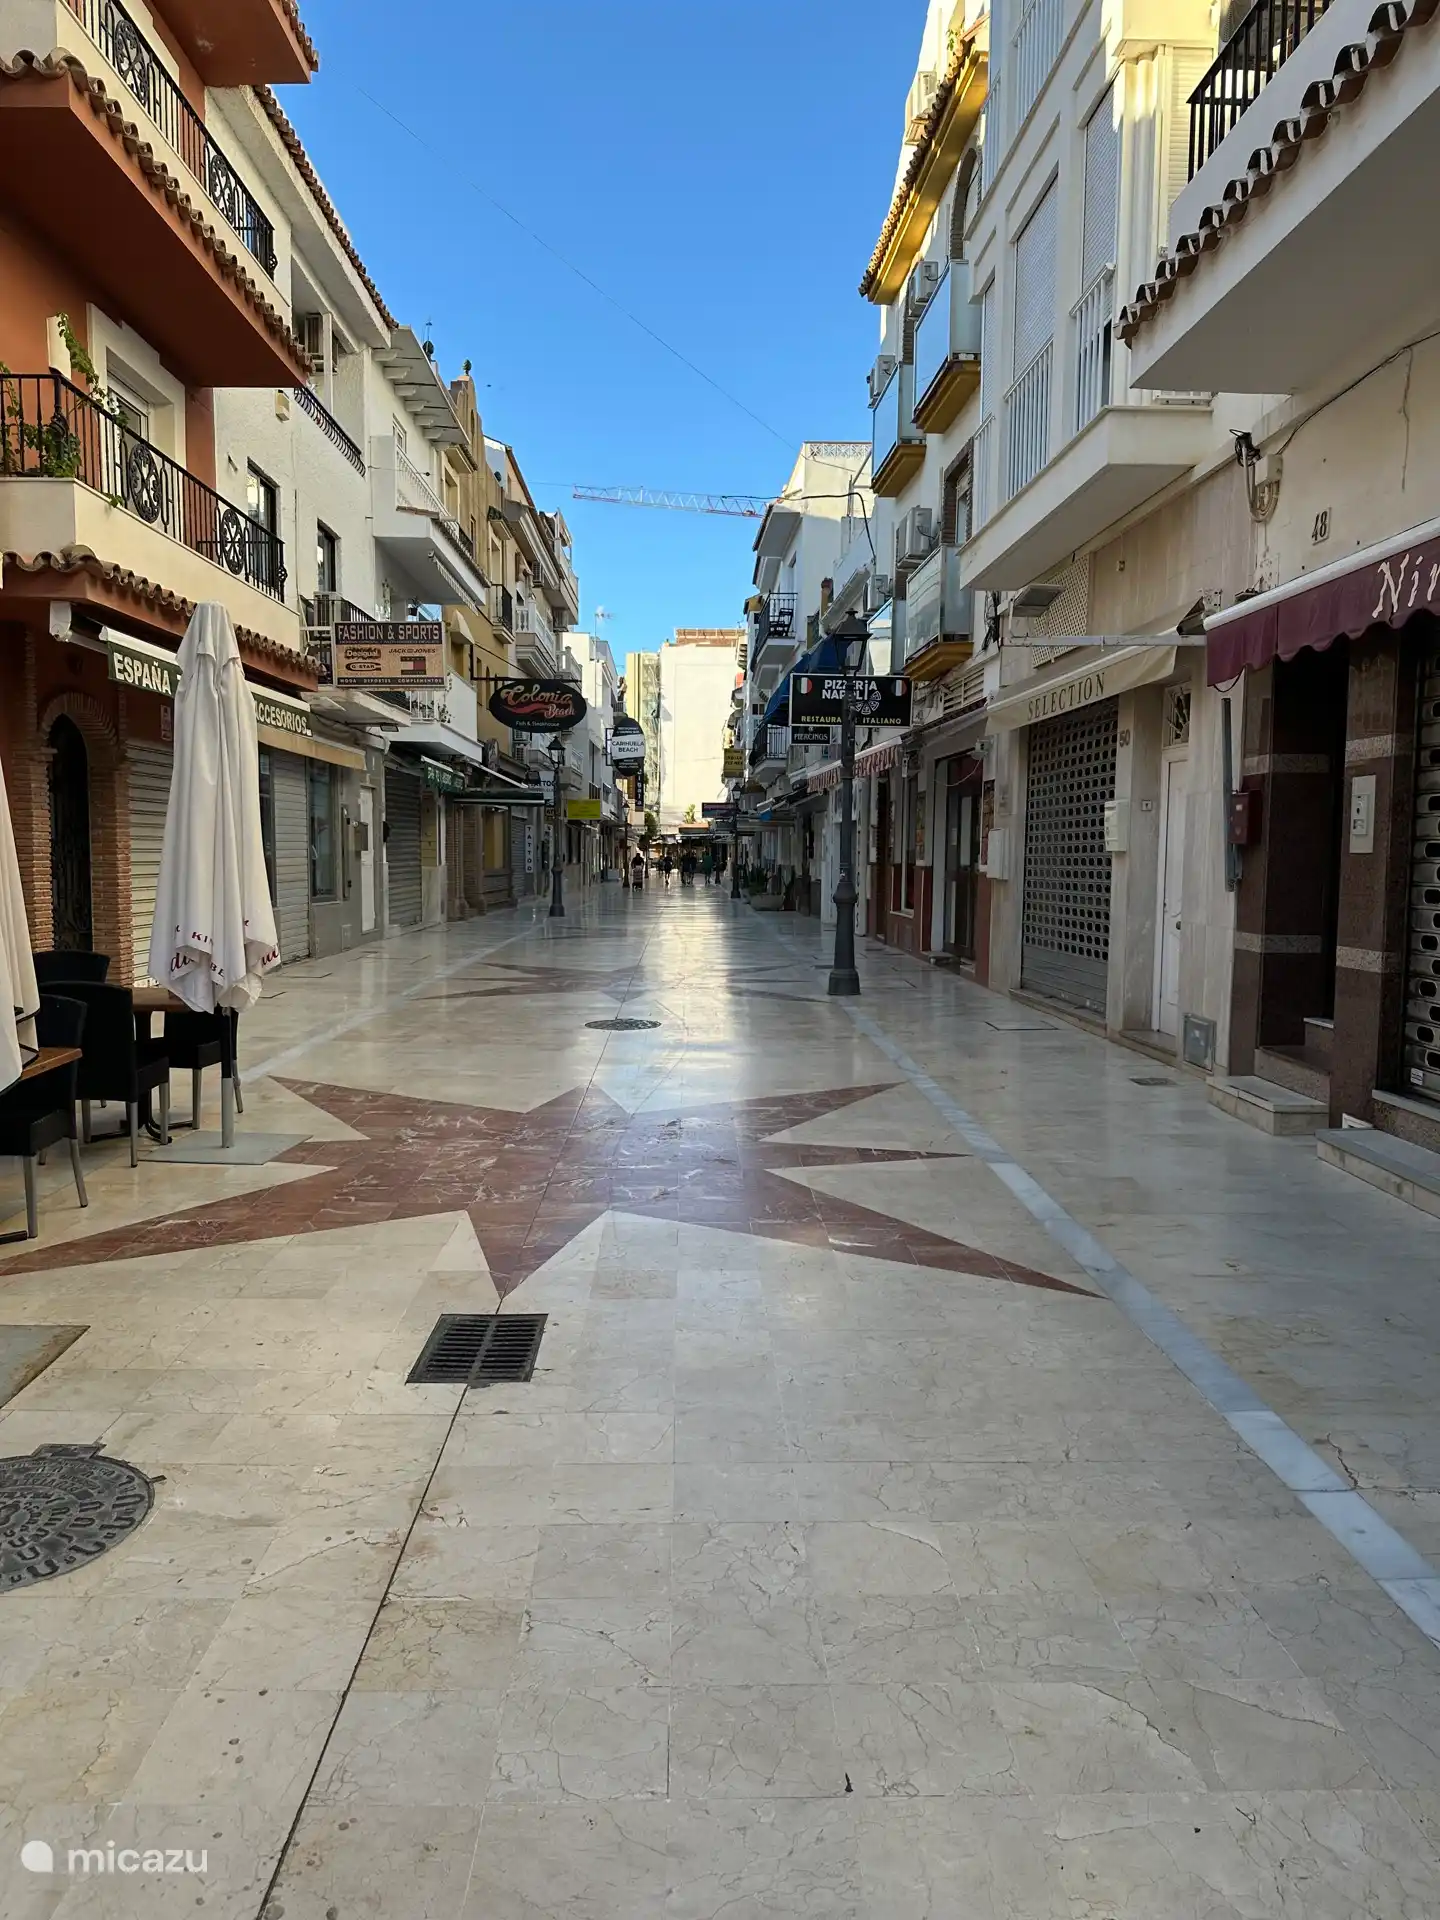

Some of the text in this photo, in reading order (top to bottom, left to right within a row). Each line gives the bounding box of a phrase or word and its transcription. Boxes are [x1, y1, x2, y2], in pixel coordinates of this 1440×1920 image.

[1311, 510, 1328, 541] 48
[338, 624, 440, 640] FASHION & SPORTS
[113, 652, 172, 695] ESPAÑA
[500, 684, 573, 706] Colonia
[1027, 672, 1105, 720] SELECTION
[543, 703, 575, 719] Beach
[1119, 729, 1131, 748] 50
